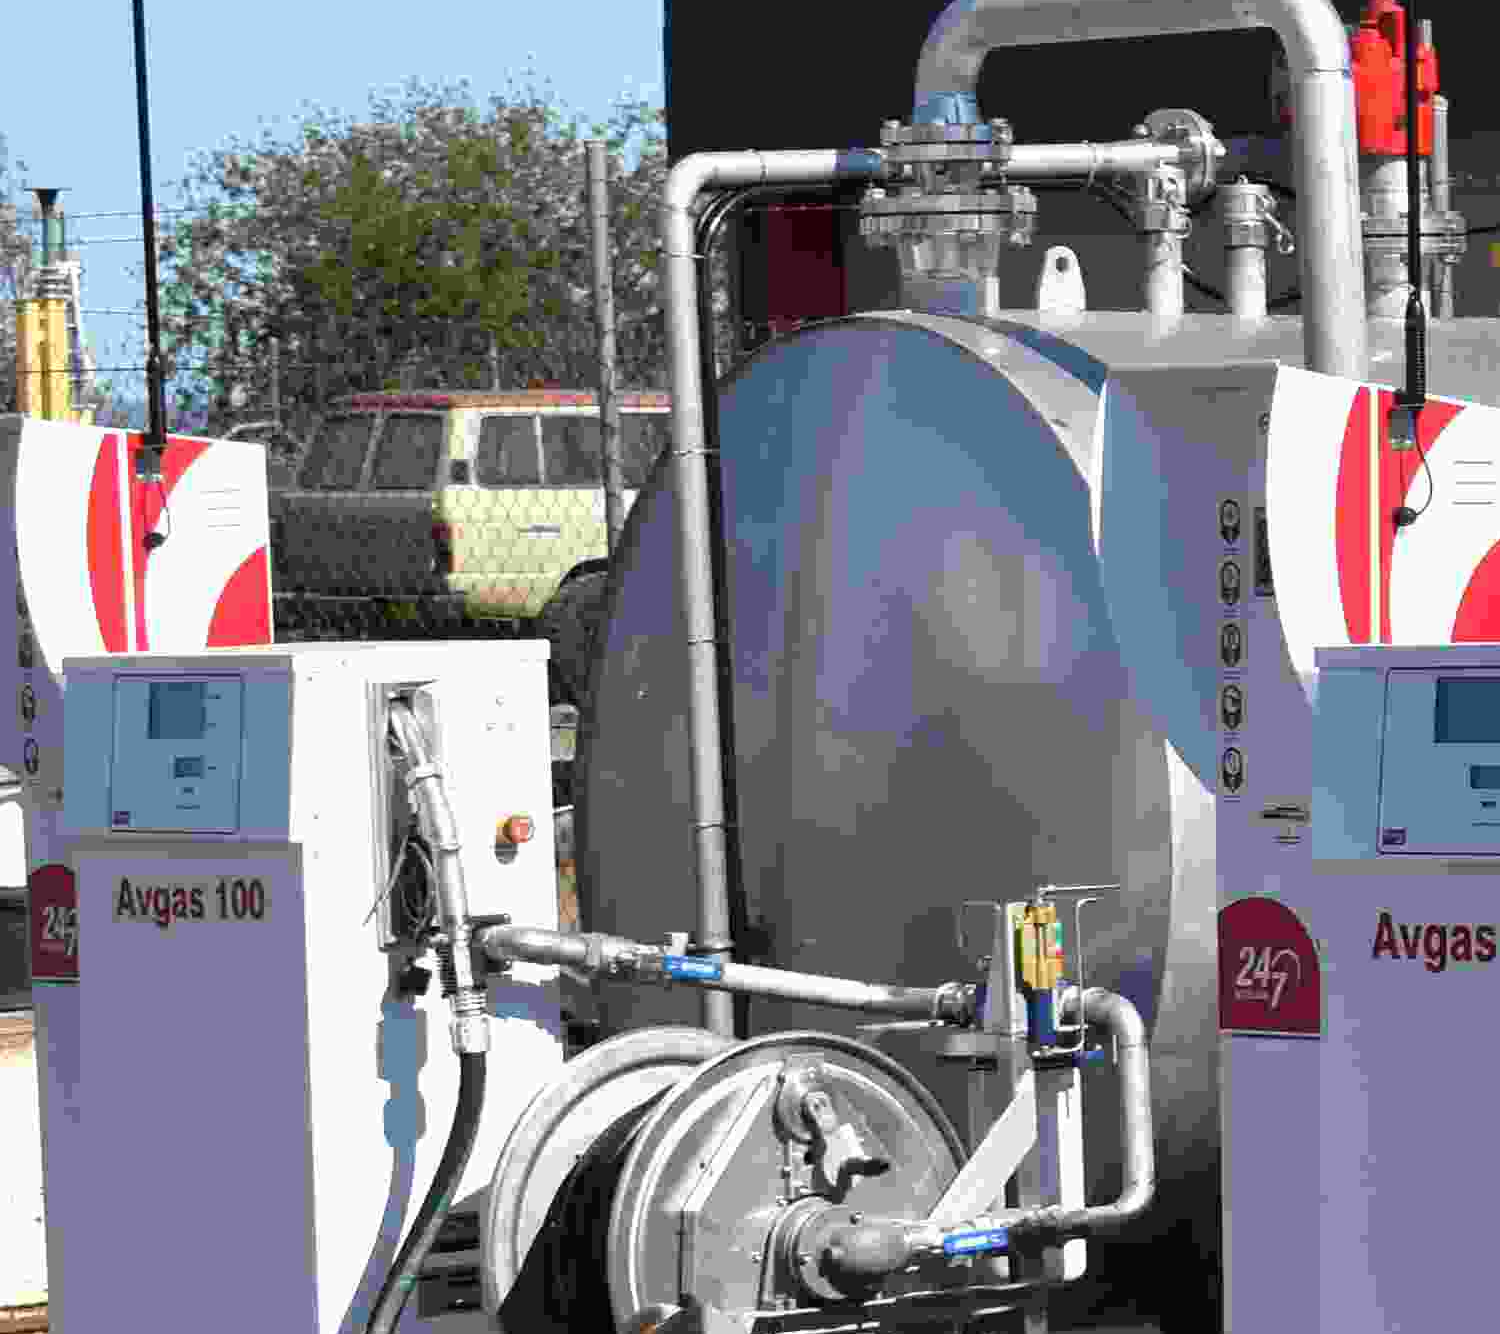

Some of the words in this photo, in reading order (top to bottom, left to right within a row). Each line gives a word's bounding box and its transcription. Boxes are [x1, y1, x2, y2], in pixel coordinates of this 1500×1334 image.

[117, 876, 205, 929] Avgas
[215, 877, 266, 919] 100
[1371, 912, 1498, 972] Avgas
